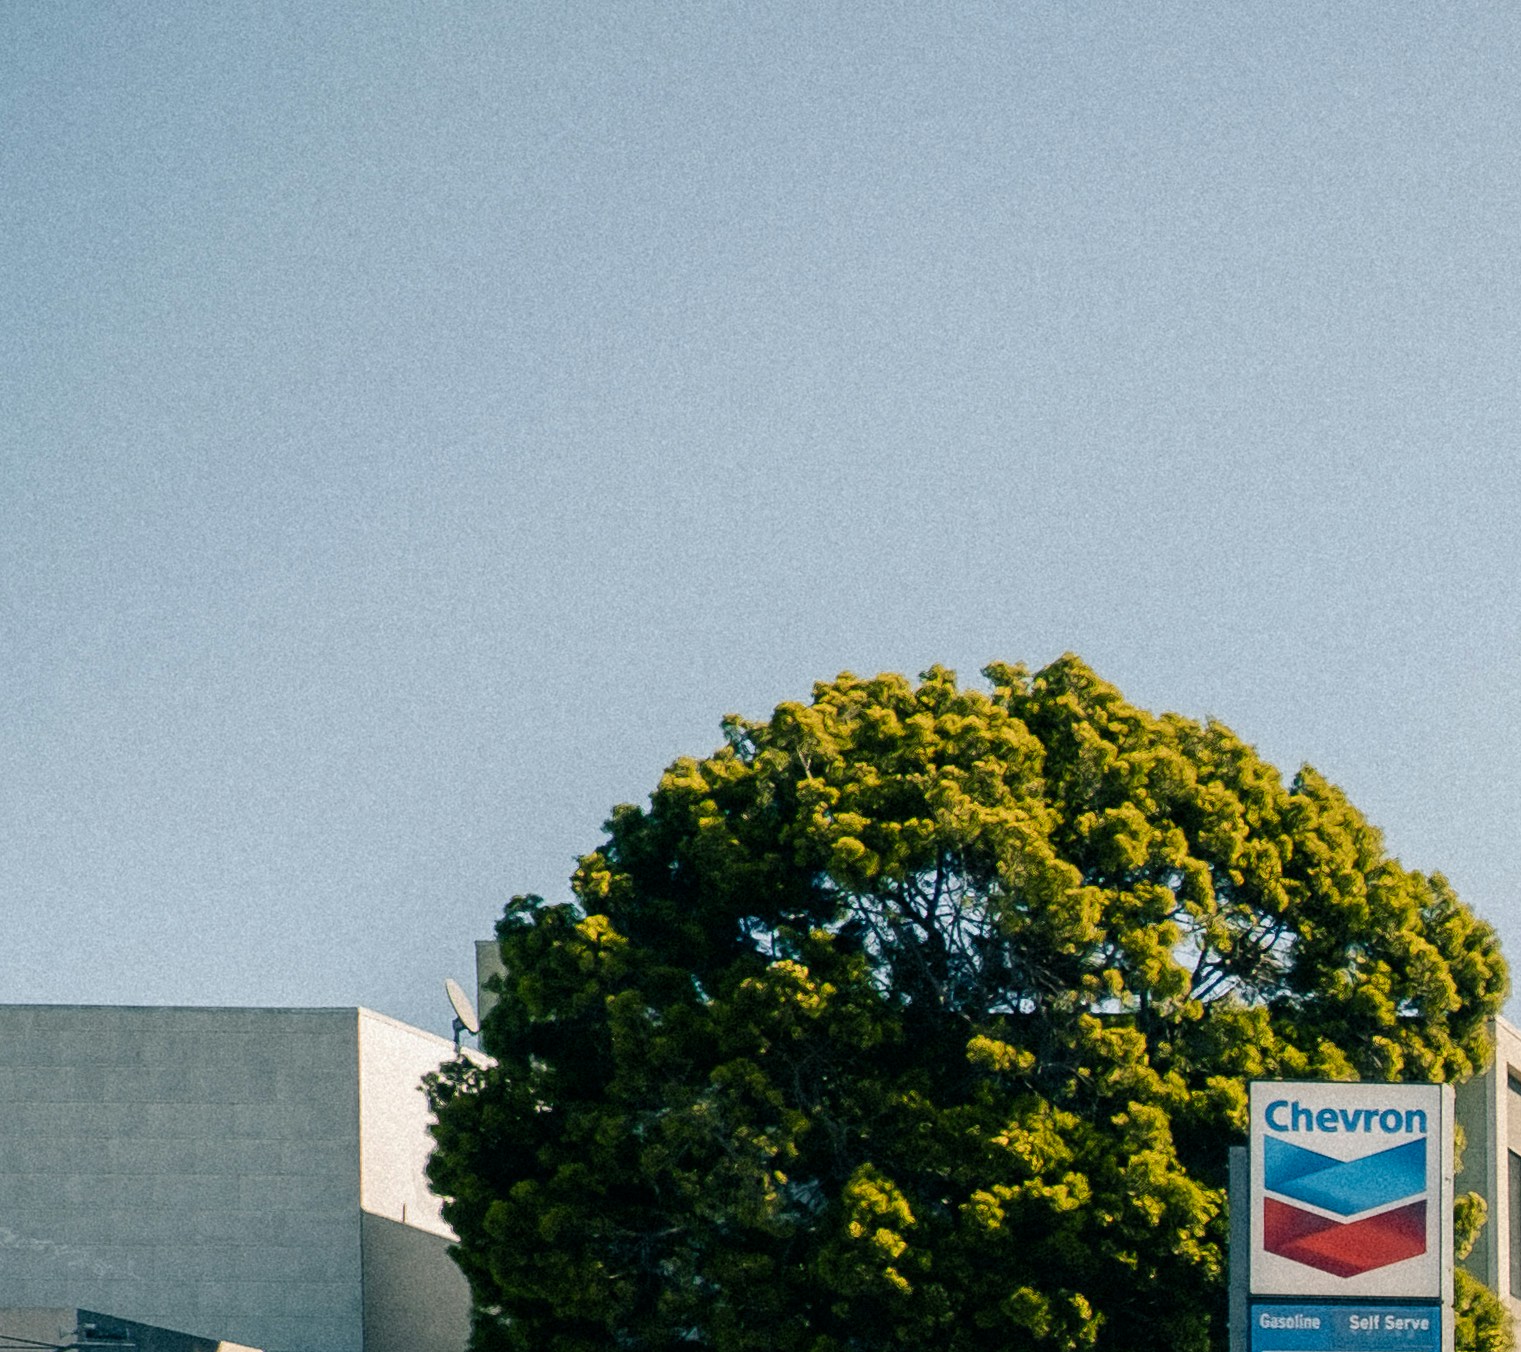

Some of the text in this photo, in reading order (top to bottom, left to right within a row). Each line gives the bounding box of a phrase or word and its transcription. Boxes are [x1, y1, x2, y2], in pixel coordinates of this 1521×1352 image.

[1264, 1100, 1428, 1134] Chevron
[1260, 1313, 1430, 1331] Gasoline Self Serve
